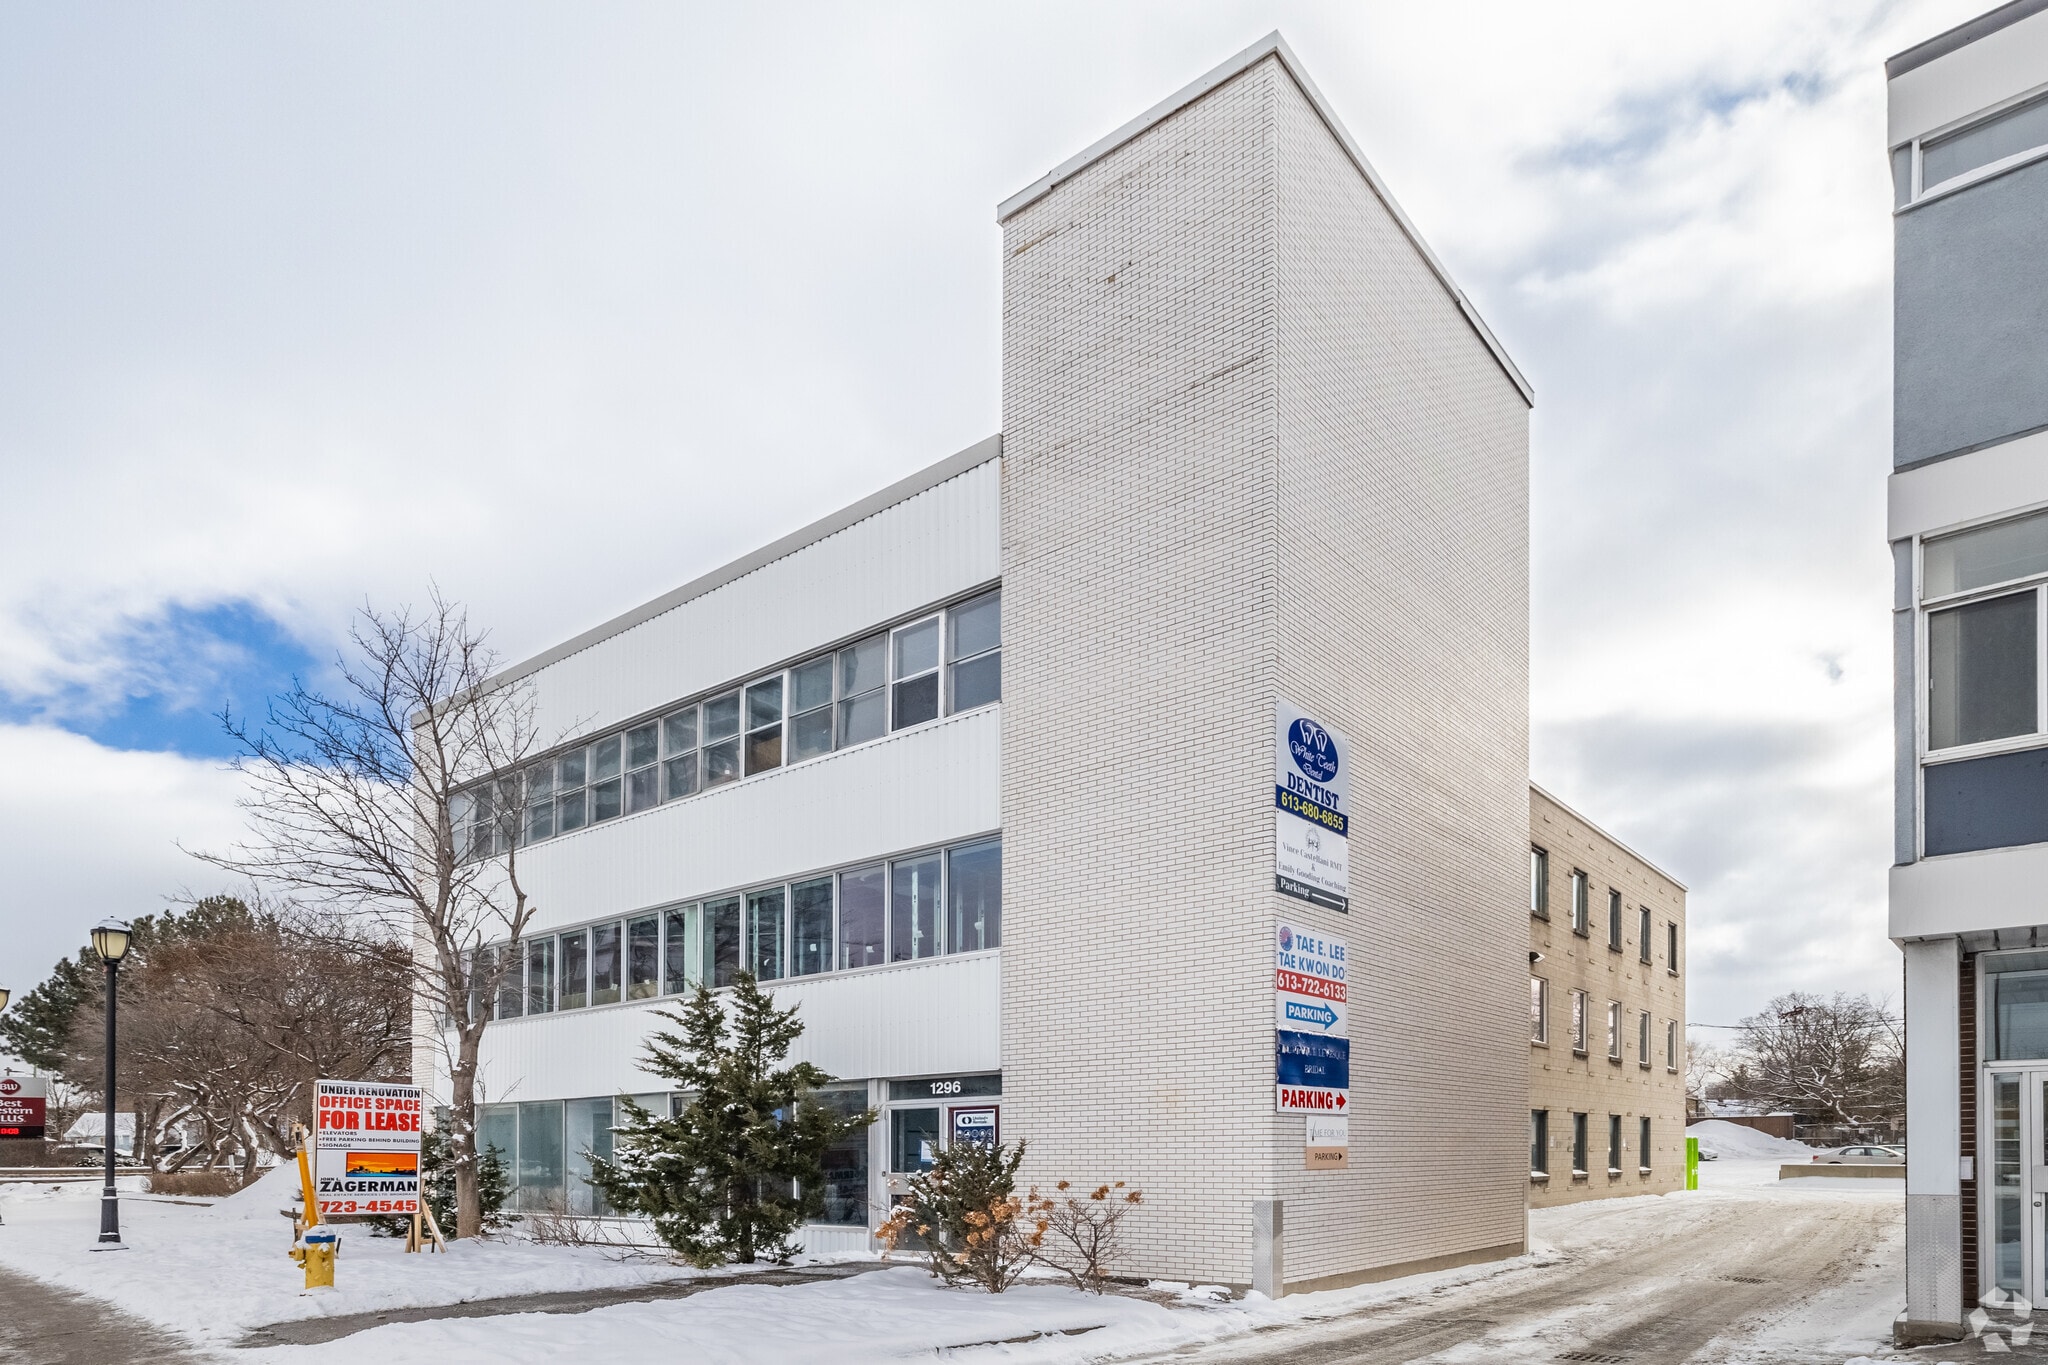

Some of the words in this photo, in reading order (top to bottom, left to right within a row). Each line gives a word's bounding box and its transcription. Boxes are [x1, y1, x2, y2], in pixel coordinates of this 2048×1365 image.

[1290, 740, 1315, 763] White
[1287, 771, 1340, 810] DENTIST
[1281, 791, 1344, 831] 613-680-6855
[1282, 841, 1299, 855] Vince
[1300, 848, 1329, 867] Castellani
[1330, 860, 1342, 872] RMT
[1278, 861, 1295, 876] Emily
[1296, 868, 1320, 884] Gooding
[1321, 876, 1347, 893] Coaching
[1280, 877, 1310, 898] Parking
[1296, 934, 1315, 954] TAE
[1318, 940, 1326, 957] E.
[1329, 943, 1345, 962] LEE
[1279, 951, 1296, 969] TAE
[1299, 956, 1330, 977] KWON
[1332, 965, 1345, 980] DO
[1277, 972, 1346, 1000] 613-722-6133
[1288, 1005, 1332, 1023] PARKING
[1304, 1064, 1326, 1075] BRIDAL
[320, 1085, 356, 1095] UNDER
[358, 1087, 420, 1098] RENOVATION
[930, 1080, 961, 1095] 1296
[319, 1095, 372, 1109] OFFICE
[375, 1097, 420, 1111] SPACE
[1281, 1088, 1333, 1110] PARKING
[0, 1115, 24, 1123] LUS
[319, 1110, 359, 1130] FOR
[365, 1111, 420, 1132] LEASE
[1324, 1128, 1335, 1137] FOR
[1314, 1152, 1338, 1161] PARKING
[319, 1181, 418, 1192] ZAGERMAN
[319, 1200, 418, 1213] 723-4545
